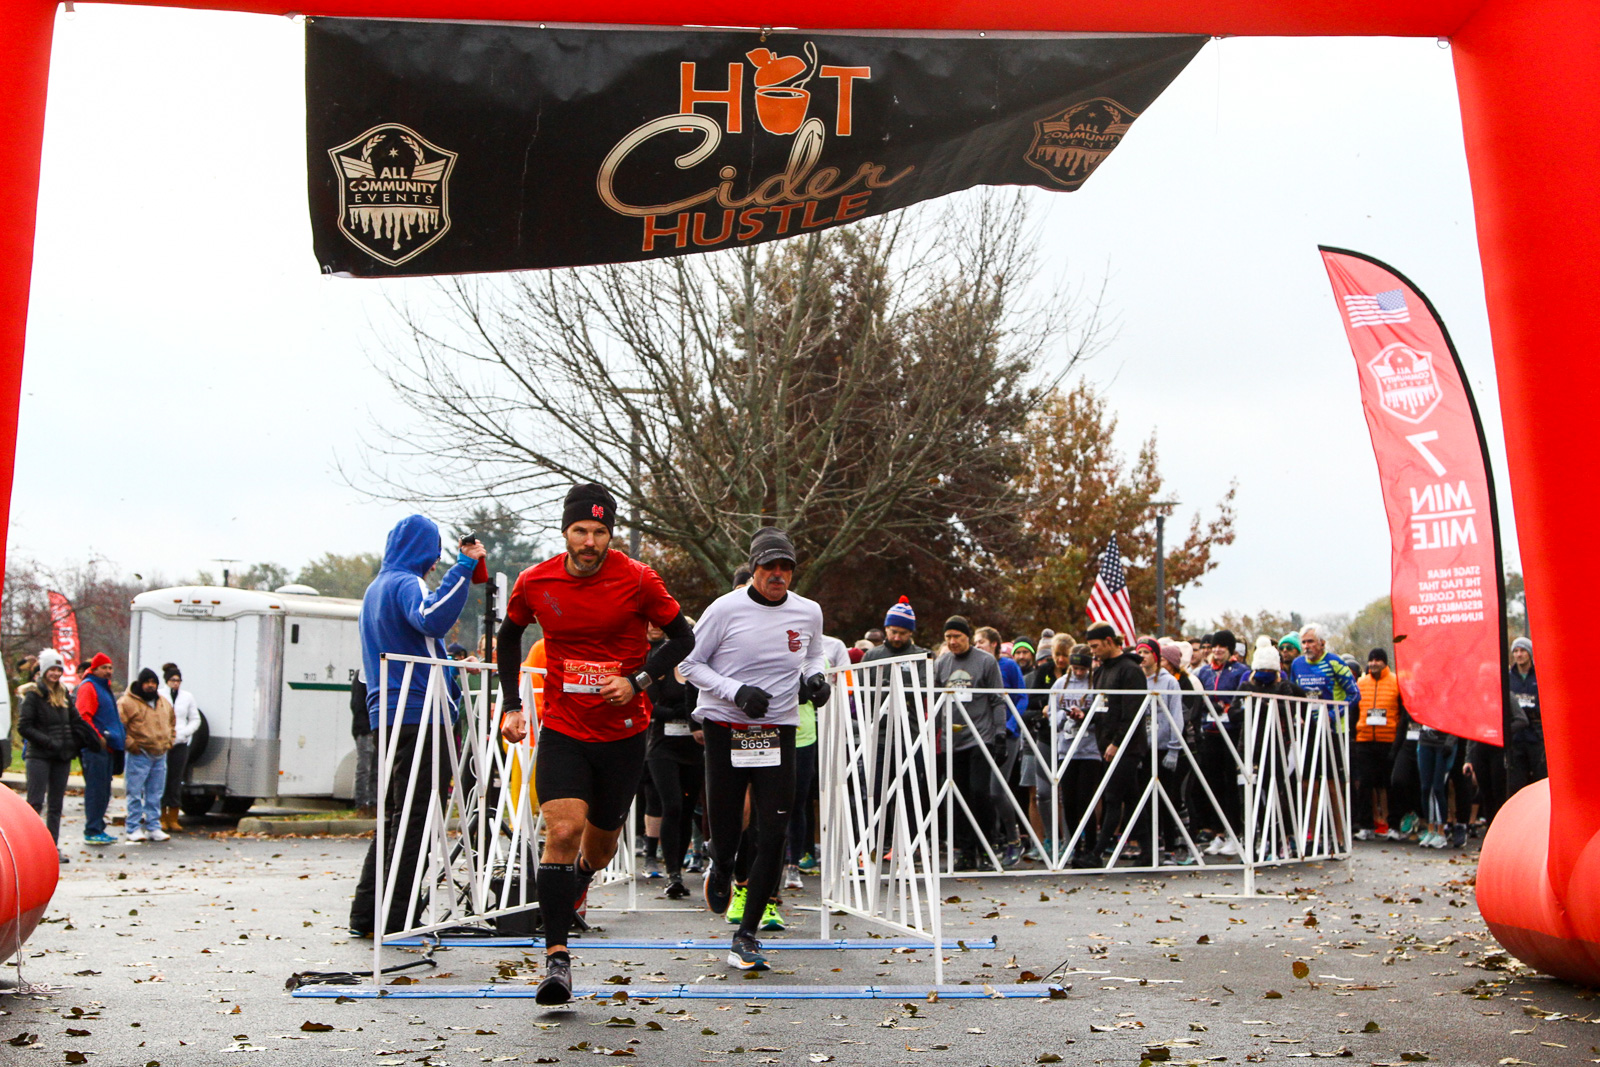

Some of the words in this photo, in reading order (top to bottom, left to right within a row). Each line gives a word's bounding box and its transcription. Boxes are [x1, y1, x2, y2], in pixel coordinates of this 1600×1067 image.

[1074, 123, 1099, 134] ALL
[597, 113, 915, 217] Cider
[379, 167, 408, 179] ALL
[349, 180, 438, 194] COMMUNITY
[354, 194, 433, 204] EVENTS
[642, 190, 873, 251] HUSTLE
[740, 739, 771, 749] 9655
